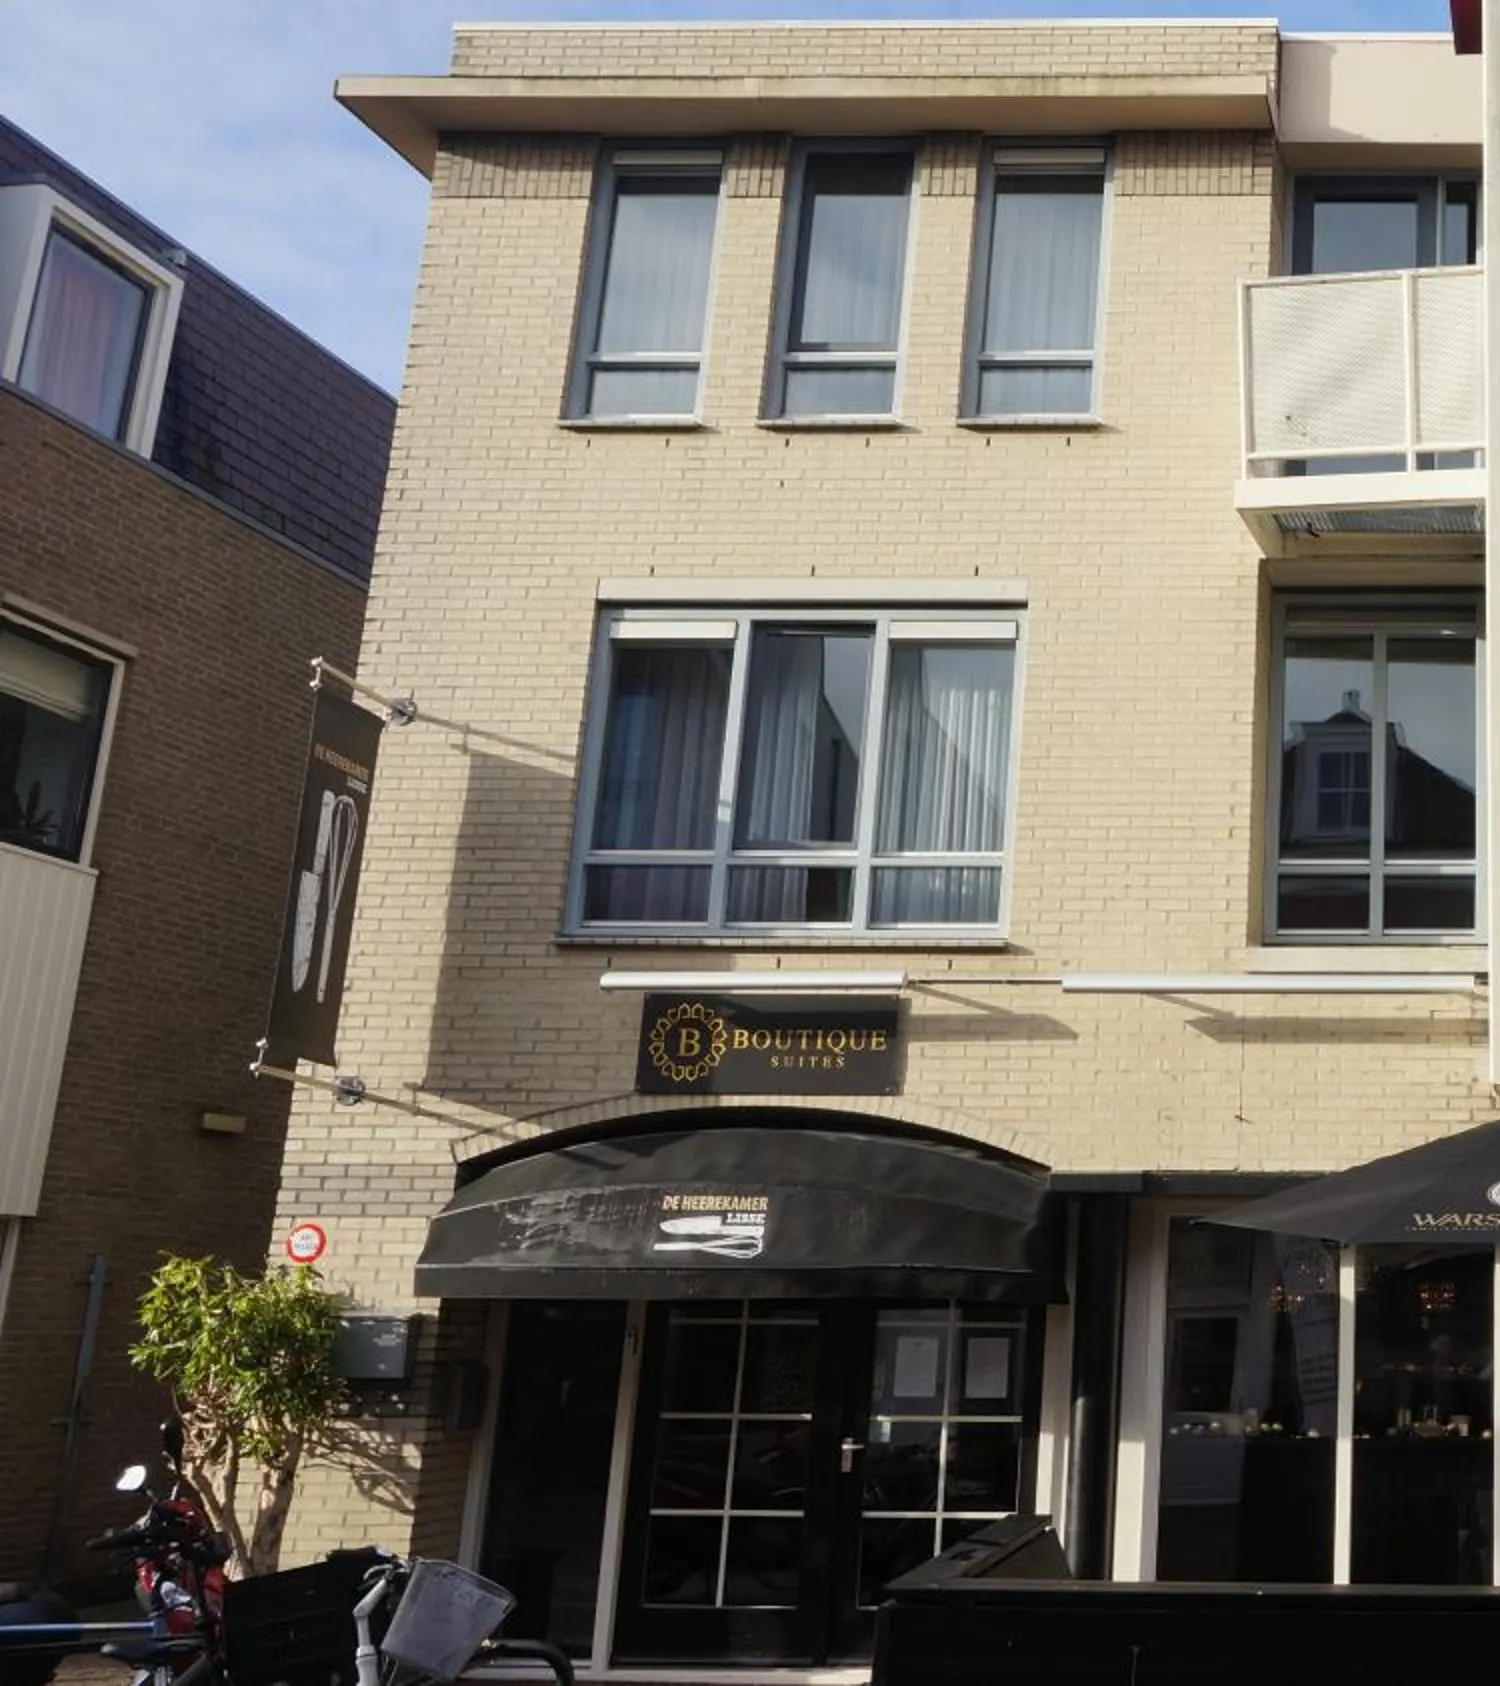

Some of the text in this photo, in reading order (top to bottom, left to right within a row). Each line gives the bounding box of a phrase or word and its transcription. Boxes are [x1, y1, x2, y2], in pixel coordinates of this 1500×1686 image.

[678, 1027, 701, 1057] B
[732, 1028, 888, 1054] BOUTIQUE
[770, 1055, 845, 1069] SUITES
[662, 1195, 769, 1212] DE HEEREKAMER
